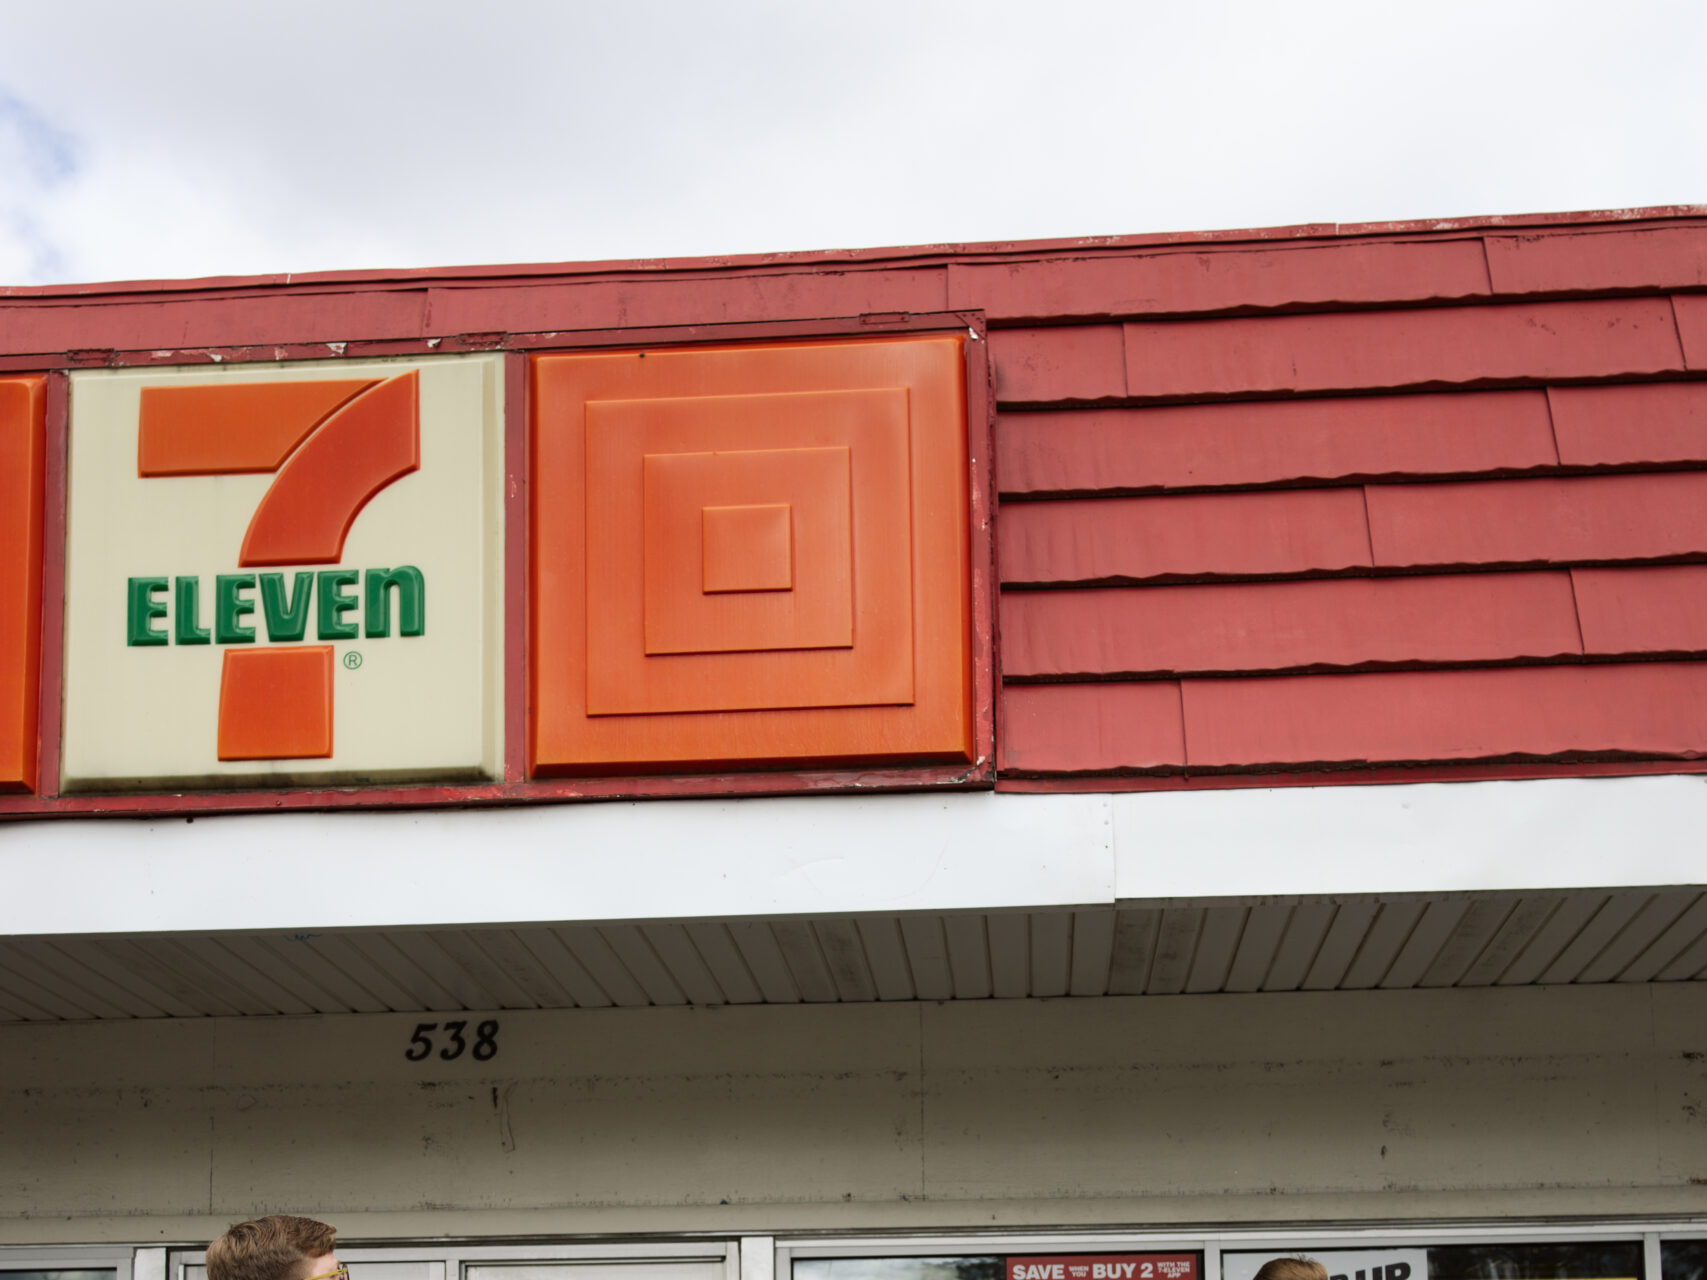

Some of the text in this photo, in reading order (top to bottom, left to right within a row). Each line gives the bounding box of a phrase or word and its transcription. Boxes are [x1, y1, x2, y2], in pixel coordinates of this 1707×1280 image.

[138, 369, 420, 762] 7
[405, 1020, 499, 1062] 538
[1012, 1264, 1065, 1280] SAVE
[1092, 1263, 1136, 1279] BUY
[1140, 1262, 1154, 1278] 2
